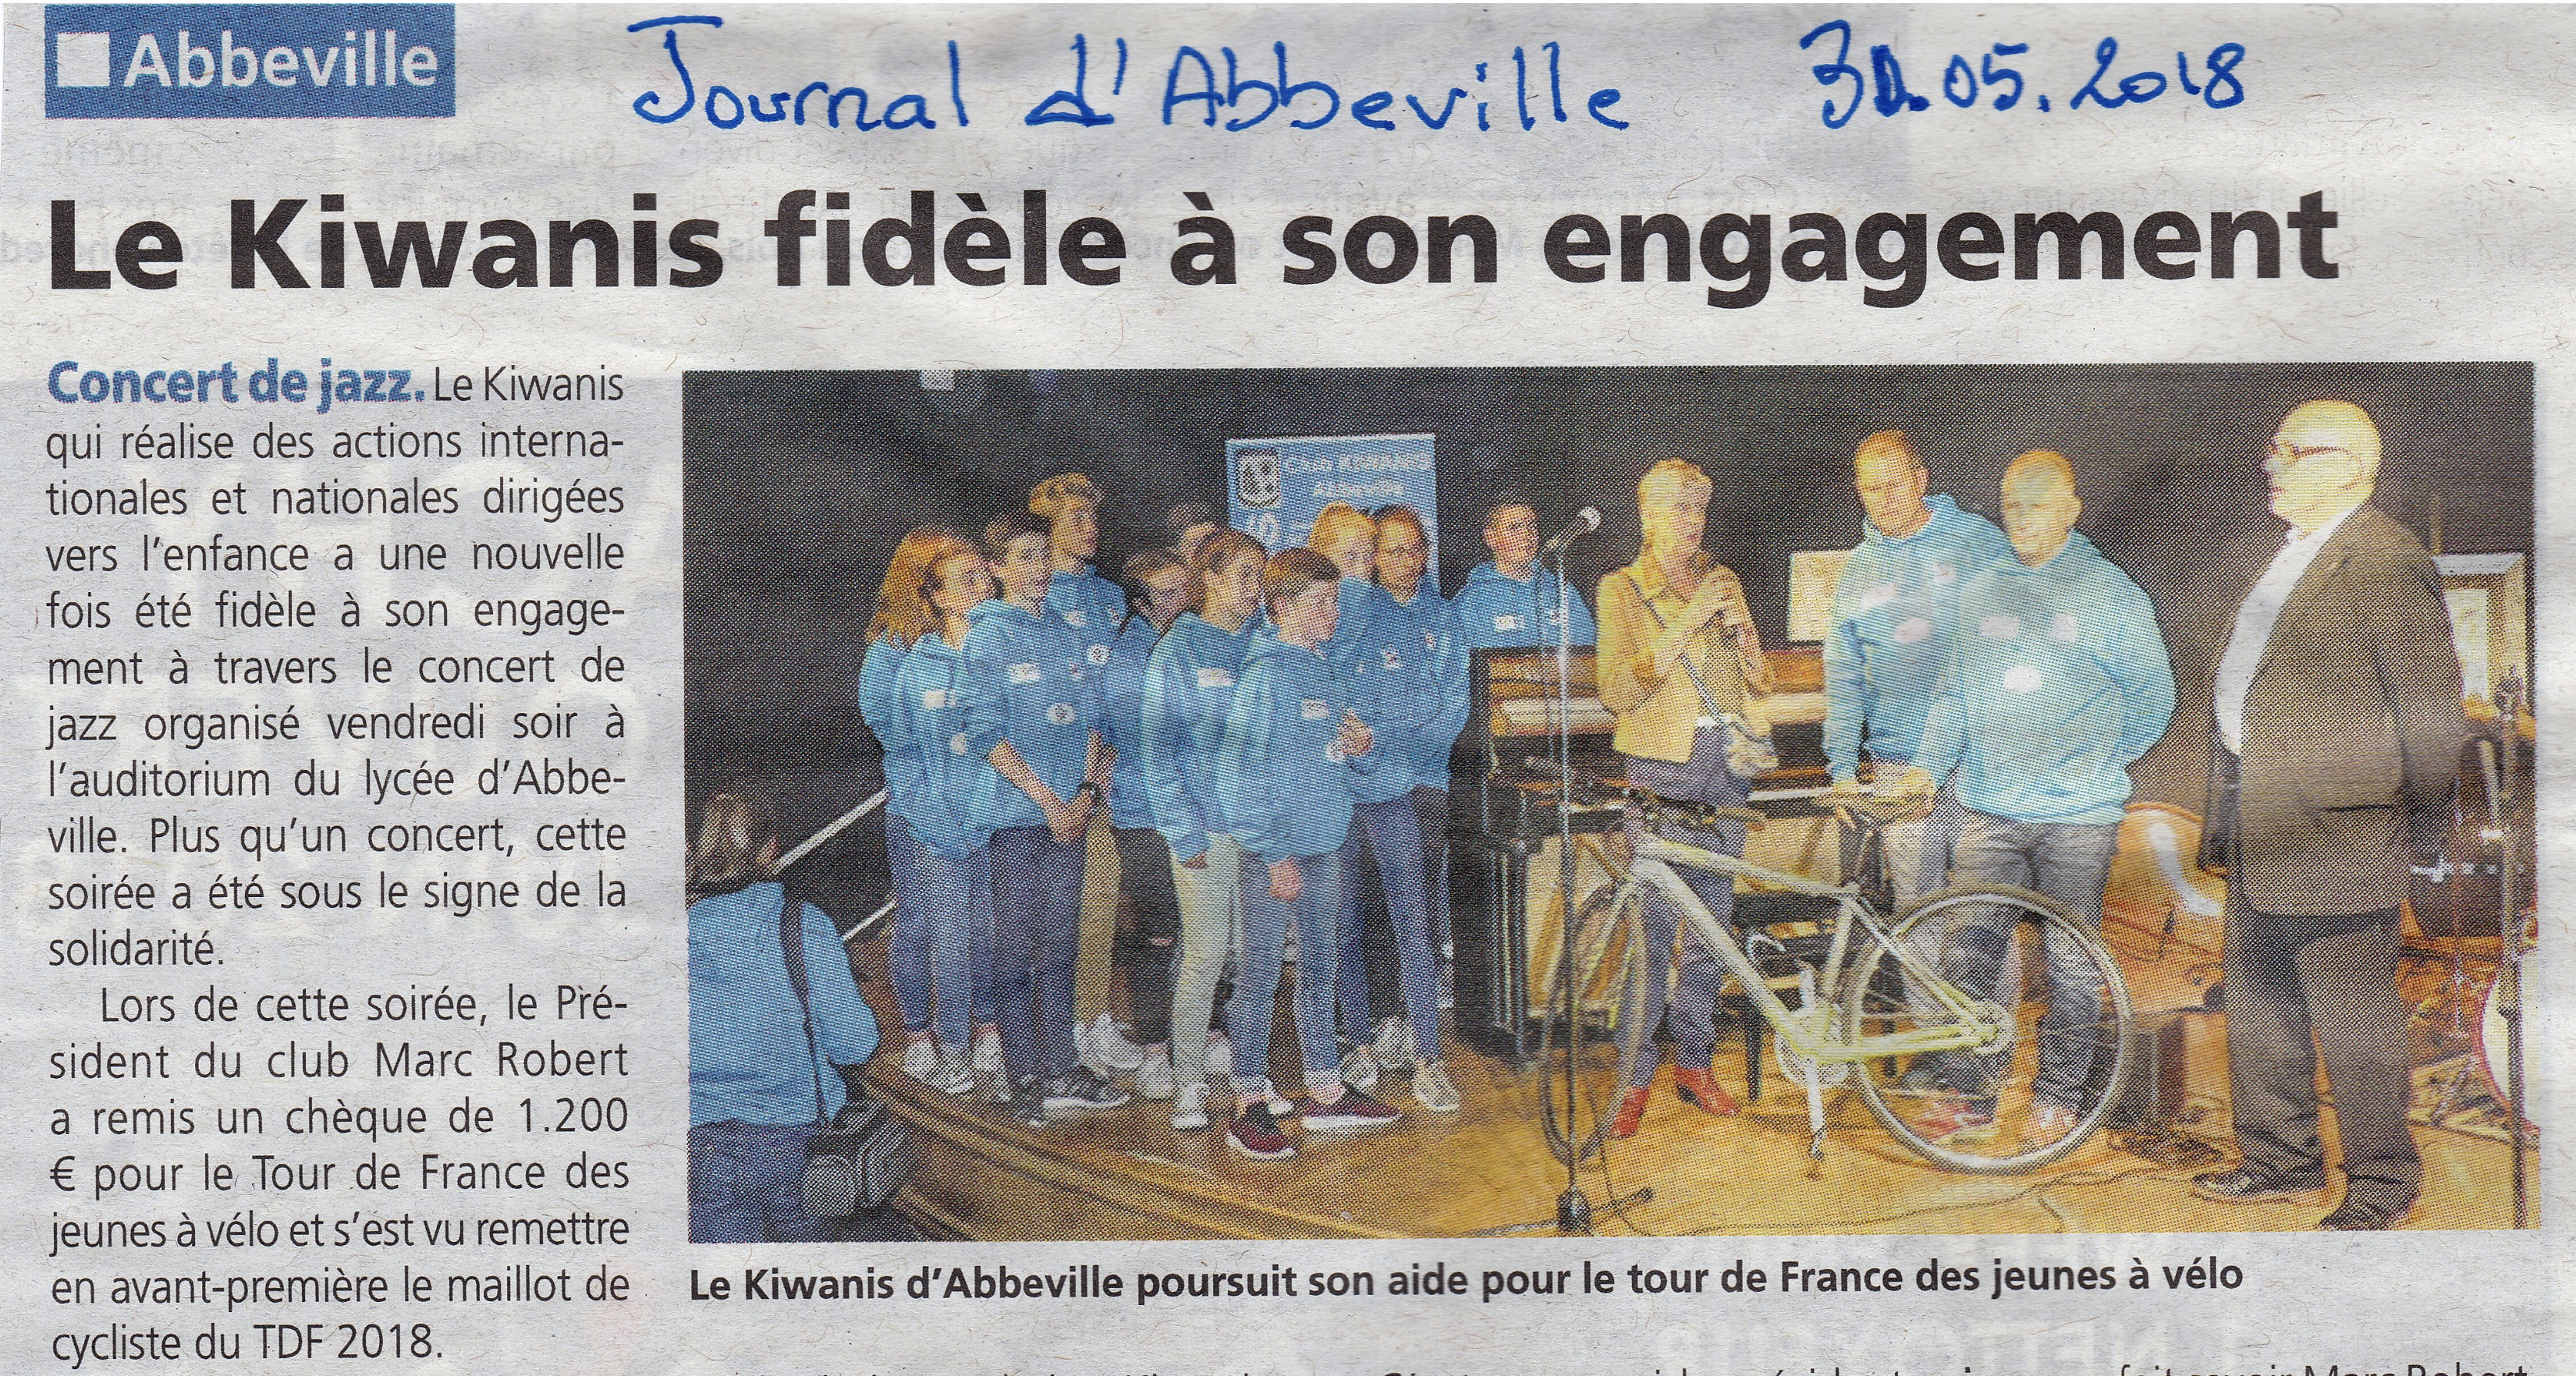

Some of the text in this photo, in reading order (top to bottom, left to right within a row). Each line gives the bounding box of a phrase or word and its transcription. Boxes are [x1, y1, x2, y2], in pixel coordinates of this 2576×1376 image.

[124, 29, 438, 87] Abbeville
[627, 16, 968, 131] Journal
[1025, 34, 1628, 132] d'Abbeville
[51, 190, 2338, 309] Le Kiwanis fidèle à son engagement
[48, 358, 623, 414] Concert de jazz. Le Kiwanis
[47, 422, 623, 469] qui réalise des actions interna-
[46, 477, 623, 523] tionales et nationales dirigées
[46, 533, 623, 571] vers l’enfance a une nouvelle
[46, 590, 624, 636] fois été fidèle à son engage-
[49, 646, 624, 684] ment à travers le concert de
[45, 703, 623, 750] jazz organisé vendredi soir à
[51, 757, 625, 805] l’auditorium du lycée d’Abbe-
[48, 816, 626, 861] ville. Plus qu’un concert, cette
[49, 871, 625, 917] soirée a été sous le signe de la
[49, 929, 225, 966] solidarité.
[102, 984, 627, 1026] Lors de cette soirée, le Pré-
[50, 1040, 628, 1079] sident du club Marc Robert
[51, 1097, 627, 1143] a remis un chèque de 1.200
[50, 1151, 629, 1200] € pour le Tour de France des
[49, 1210, 629, 1257] jeunes à vélo et s’est vu remettre
[52, 1264, 629, 1312] en avant-première le maillot de
[691, 1256, 2243, 1305] Le Kiwanis d’Abbeville poursuit son aide pour le tour de France des jeunes à vélo
[53, 1323, 442, 1370] cycliste du TDF 2018.
